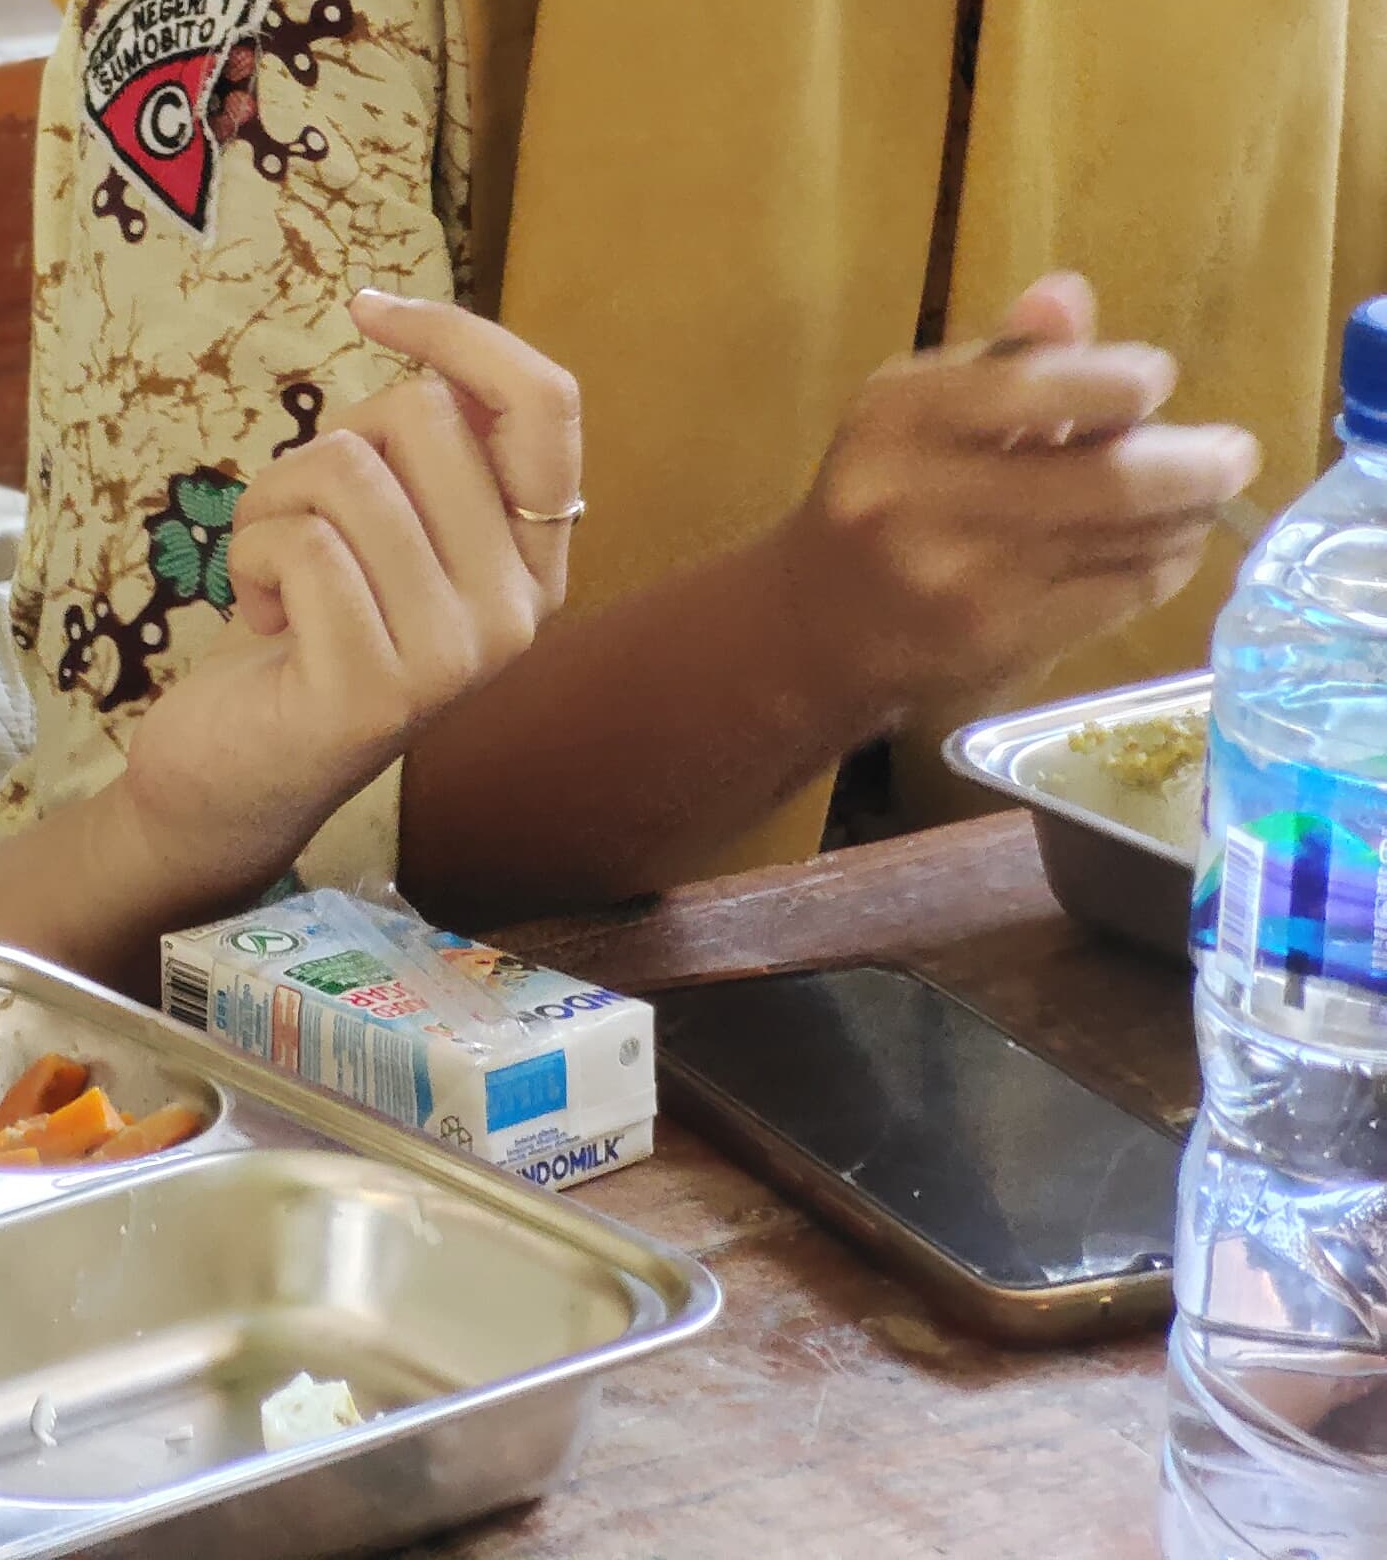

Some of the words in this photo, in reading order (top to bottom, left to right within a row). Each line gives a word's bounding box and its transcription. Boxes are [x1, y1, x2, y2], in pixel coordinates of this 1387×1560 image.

[92, 17, 216, 96] SUMOBITO
[151, 92, 187, 149] C
[516, 1137, 622, 1187] NDOMILK
